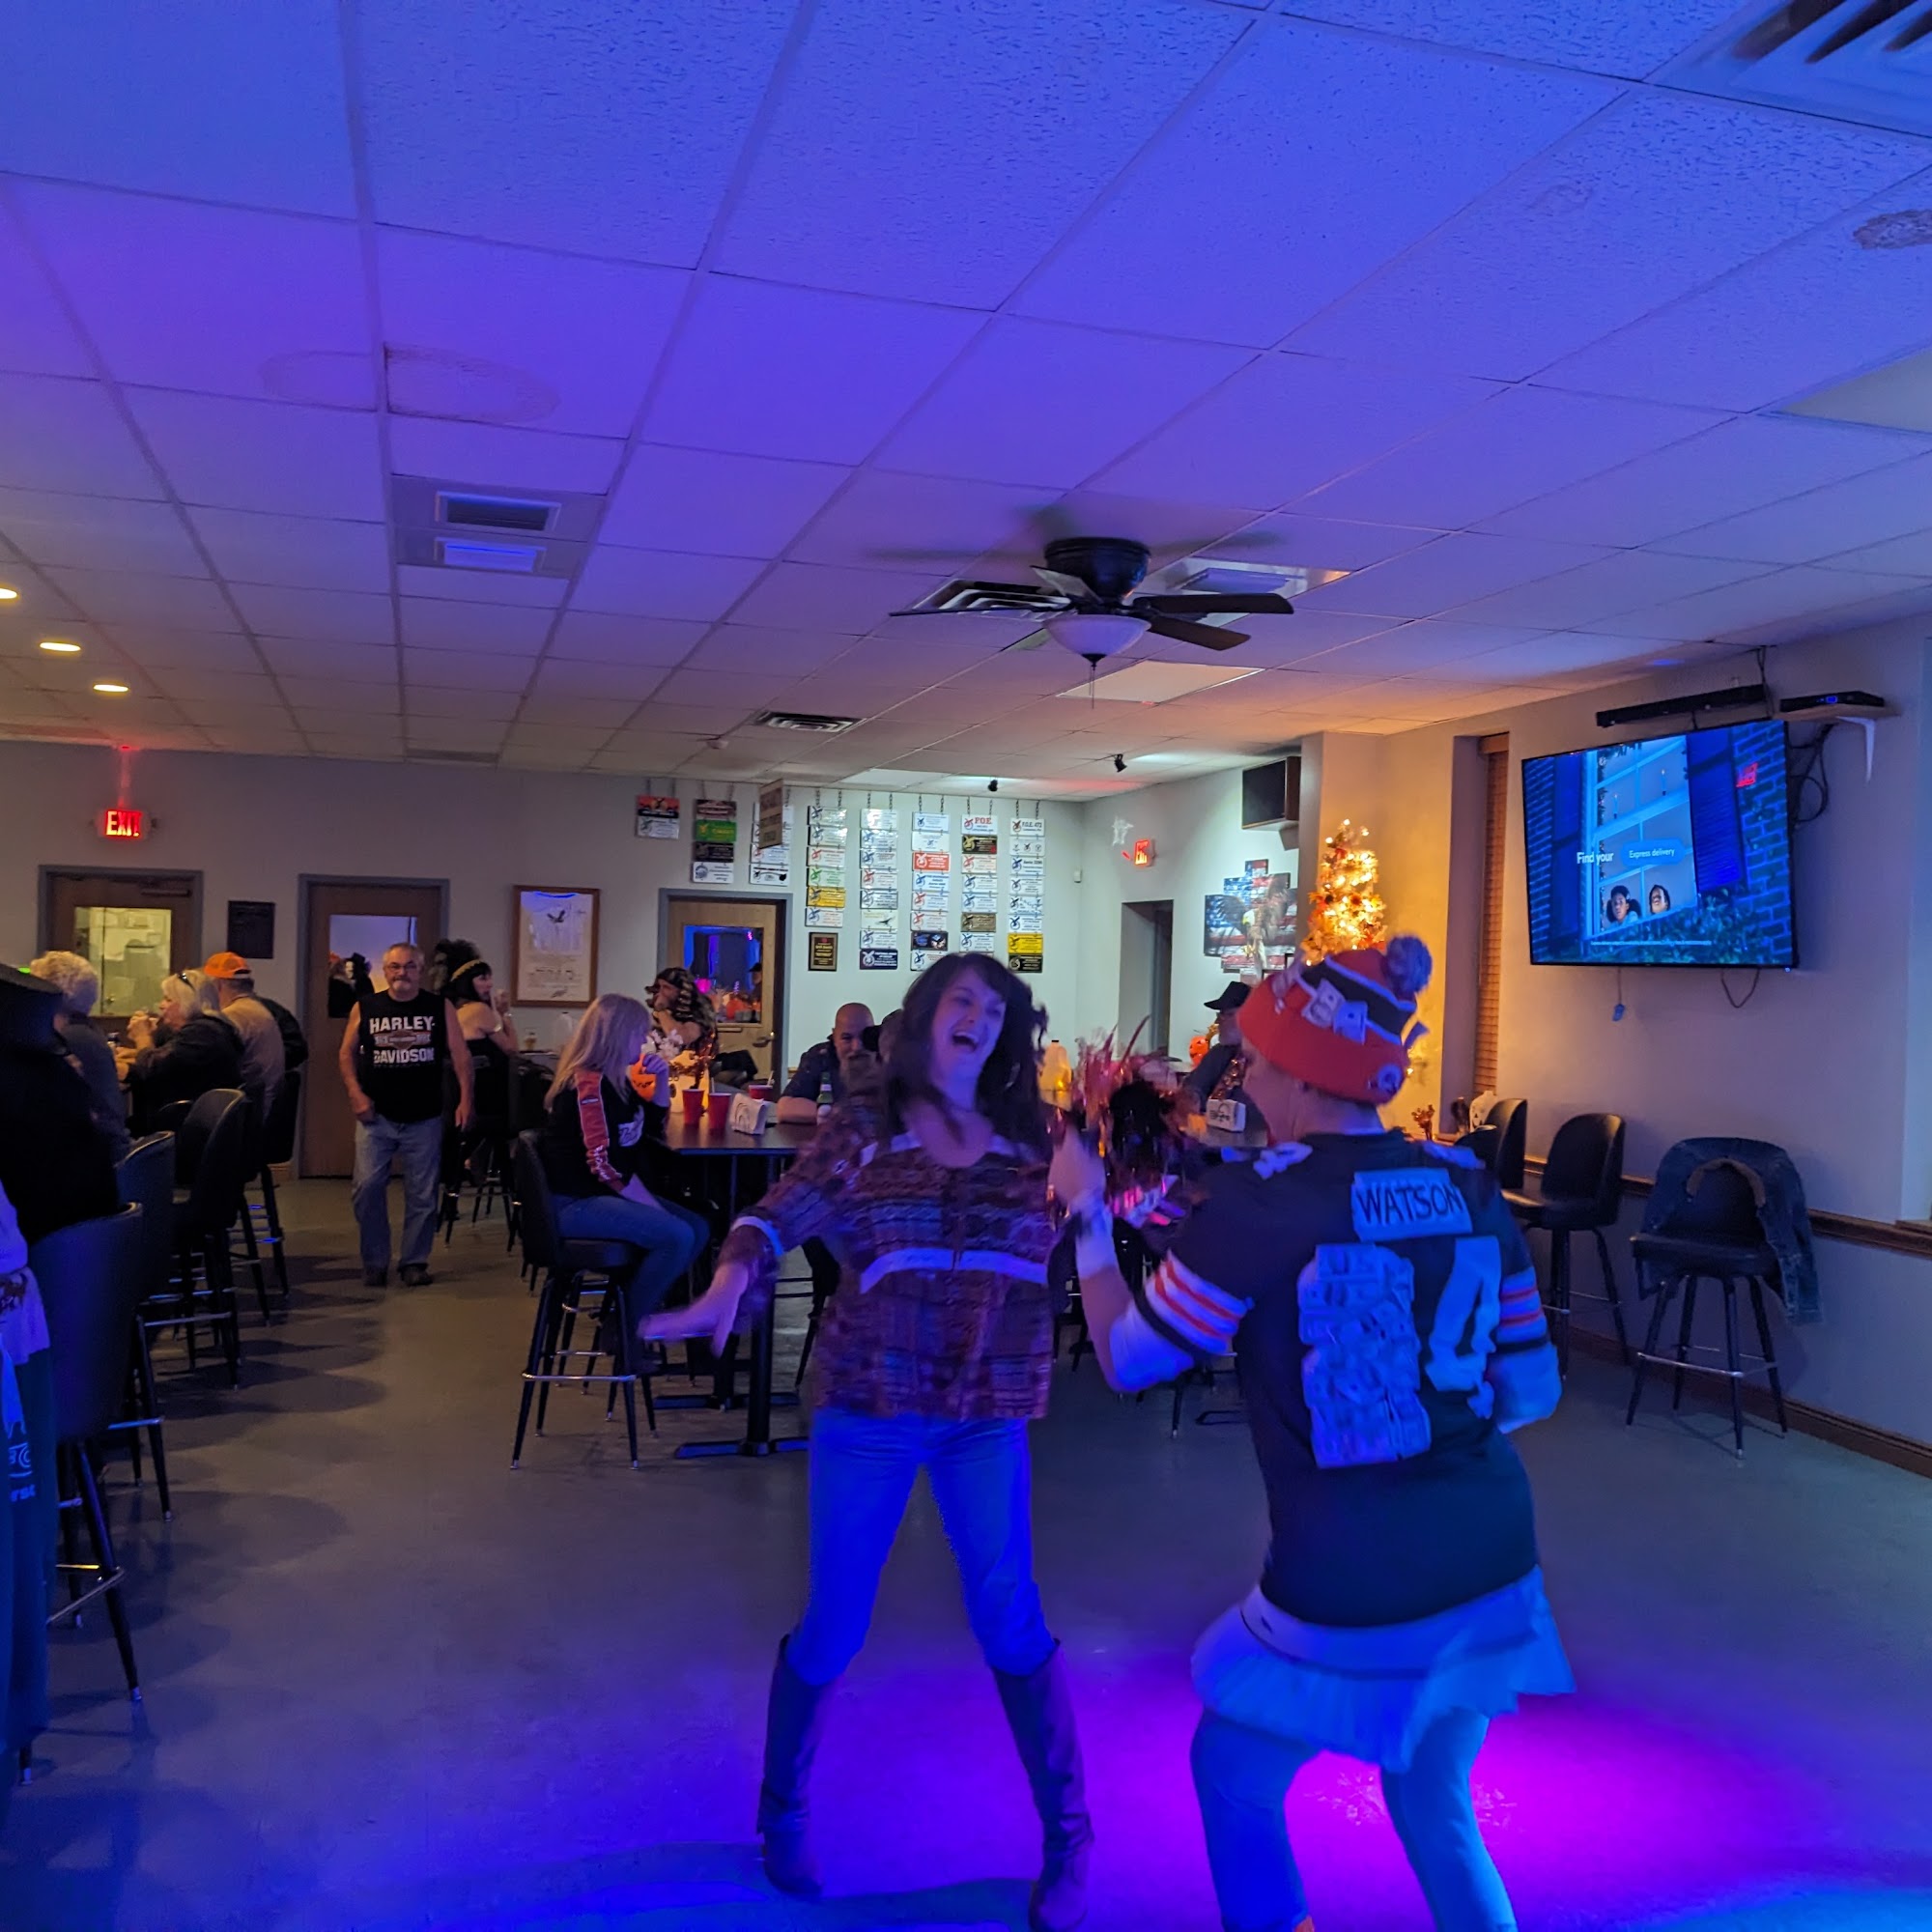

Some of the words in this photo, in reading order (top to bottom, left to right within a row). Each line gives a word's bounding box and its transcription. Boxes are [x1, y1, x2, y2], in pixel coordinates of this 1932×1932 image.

[106, 810, 140, 838] EXIT
[1577, 851, 1594, 864] Find
[1596, 852, 1614, 866] your
[1629, 850, 1651, 859] Express
[1652, 848, 1675, 858] delivery
[369, 1015, 436, 1035] HARLEY-
[373, 1047, 435, 1065] DAVIDSON
[1355, 1182, 1464, 1226] WATSON
